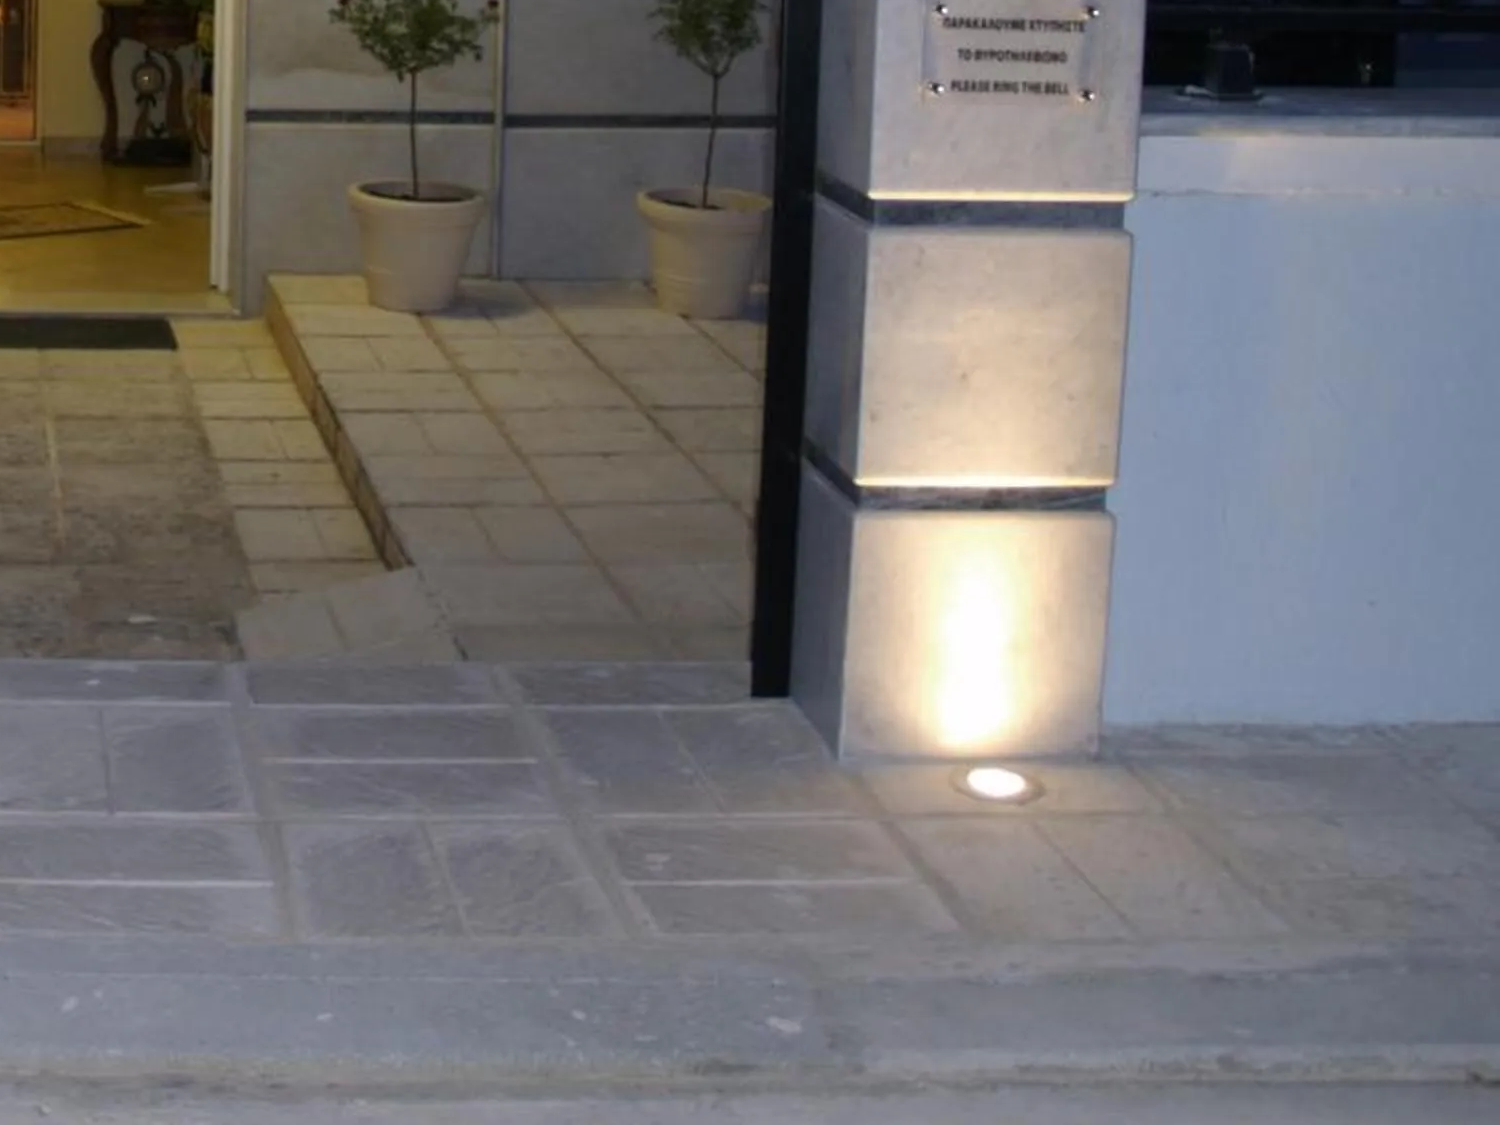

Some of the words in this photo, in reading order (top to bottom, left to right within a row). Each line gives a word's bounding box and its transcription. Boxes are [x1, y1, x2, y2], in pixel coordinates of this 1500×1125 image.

[951, 80, 990, 92] PLEASE
[993, 80, 1019, 93] RING
[1022, 81, 1041, 93] THE
[1044, 82, 1069, 94] BELL
